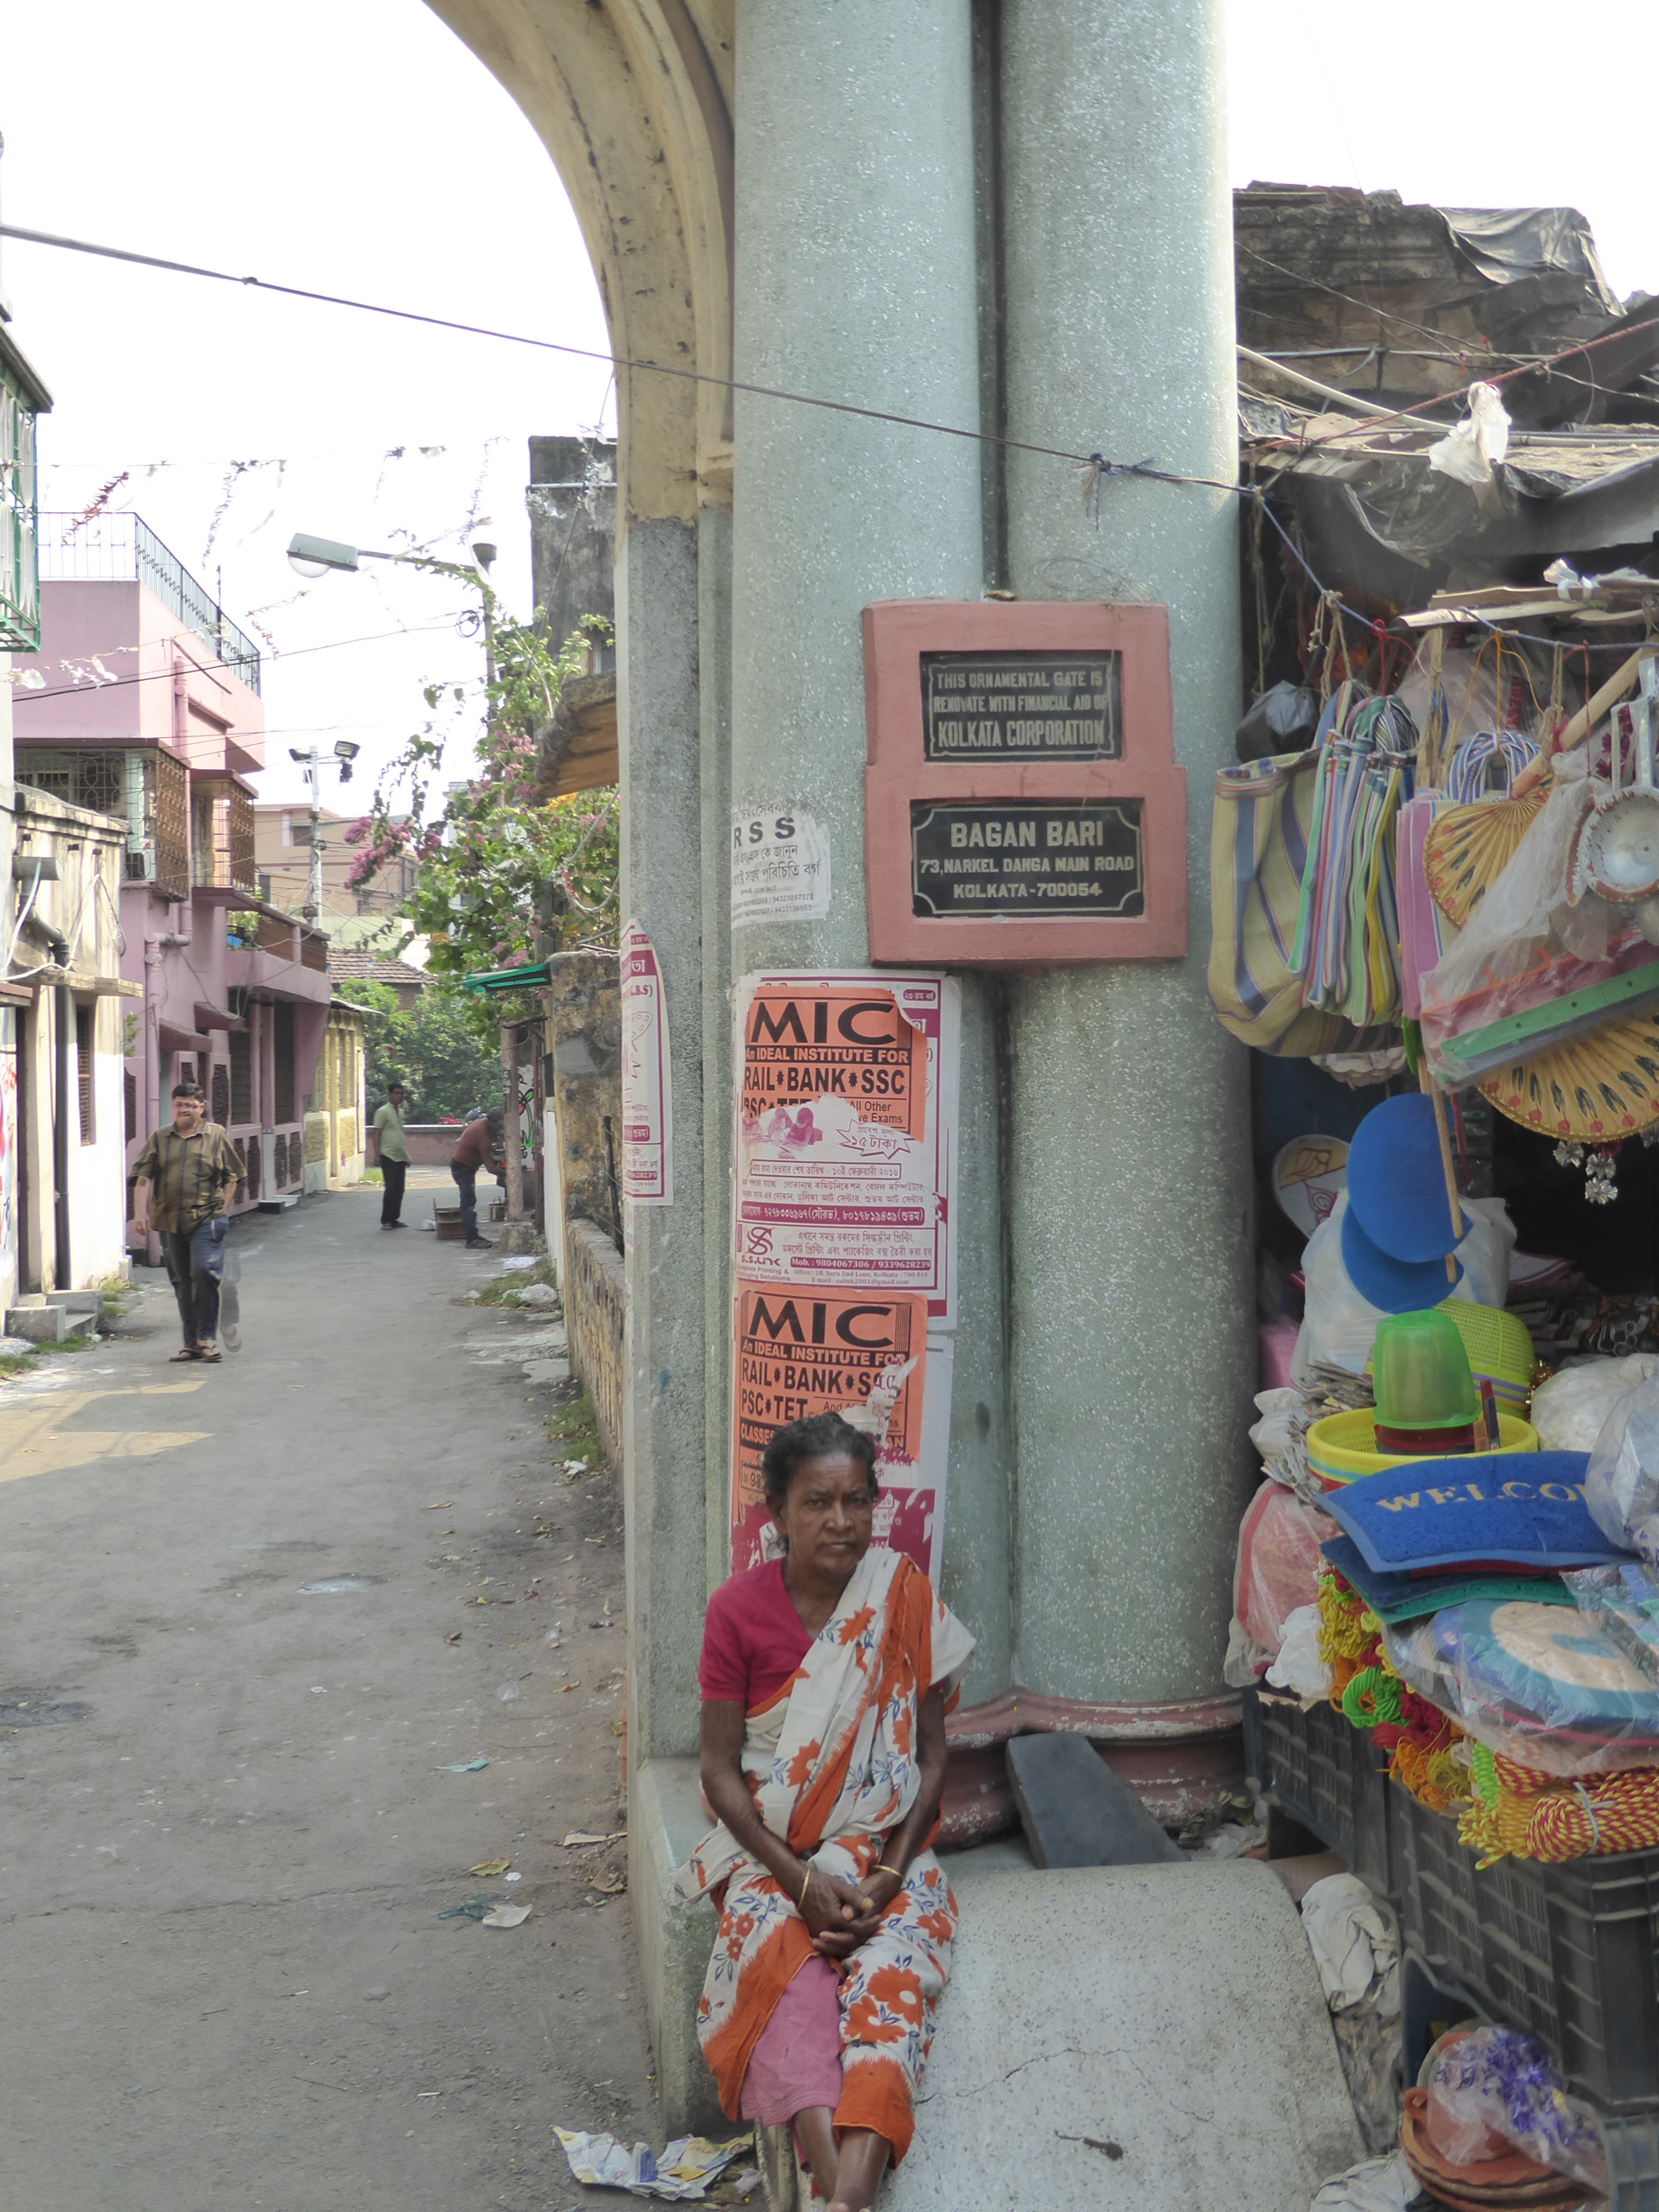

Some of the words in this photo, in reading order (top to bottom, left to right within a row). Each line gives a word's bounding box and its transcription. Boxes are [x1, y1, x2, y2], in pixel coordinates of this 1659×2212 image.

[937, 673, 966, 689] THIS
[969, 671, 1050, 688] ORNAMENTAL
[1053, 671, 1086, 687] GATE
[1090, 671, 1103, 686] IS
[933, 696, 986, 713] RENOVATE
[988, 695, 1016, 712] WITH
[1018, 695, 1071, 711] FINANCIAL
[1074, 694, 1091, 710] AID
[938, 720, 1002, 747] KOLKATA
[1006, 719, 1105, 746] CORPORATION
[950, 821, 1037, 848] BAGAN
[1046, 820, 1103, 847] BARI
[1002, 857, 1051, 873] DANGA
[1054, 856, 1090, 872] MAIN
[1094, 855, 1135, 871] ROAD
[751, 1001, 897, 1046] MIC
[746, 1048, 754, 1059] An
[757, 1047, 790, 1060] IDEAL
[794, 1048, 873, 1062] INSTITUTE
[878, 1050, 909, 1063] FOR
[744, 1066, 775, 1091] RAIL
[787, 1066, 847, 1093] BANK
[861, 1068, 906, 1095] SSC
[864, 1100, 892, 1111] Other
[872, 1113, 903, 1124] Exams
[869, 1134, 898, 1150] টাকা
[758, 1266, 782, 1275] Printing
[816, 1258, 869, 1268] 9804067306
[878, 1260, 931, 1269] 9339628239
[749, 1296, 894, 1348] MIC
[742, 1339, 753, 1353] An
[754, 1342, 788, 1359] IDEAL
[791, 1345, 870, 1365] INSTITUTE
[742, 1357, 772, 1387] RAIL
[784, 1364, 844, 1395] BANK
[741, 1388, 764, 1417] PSC
[773, 1395, 808, 1422] TET
[1376, 1481, 1587, 1512] WELCO
